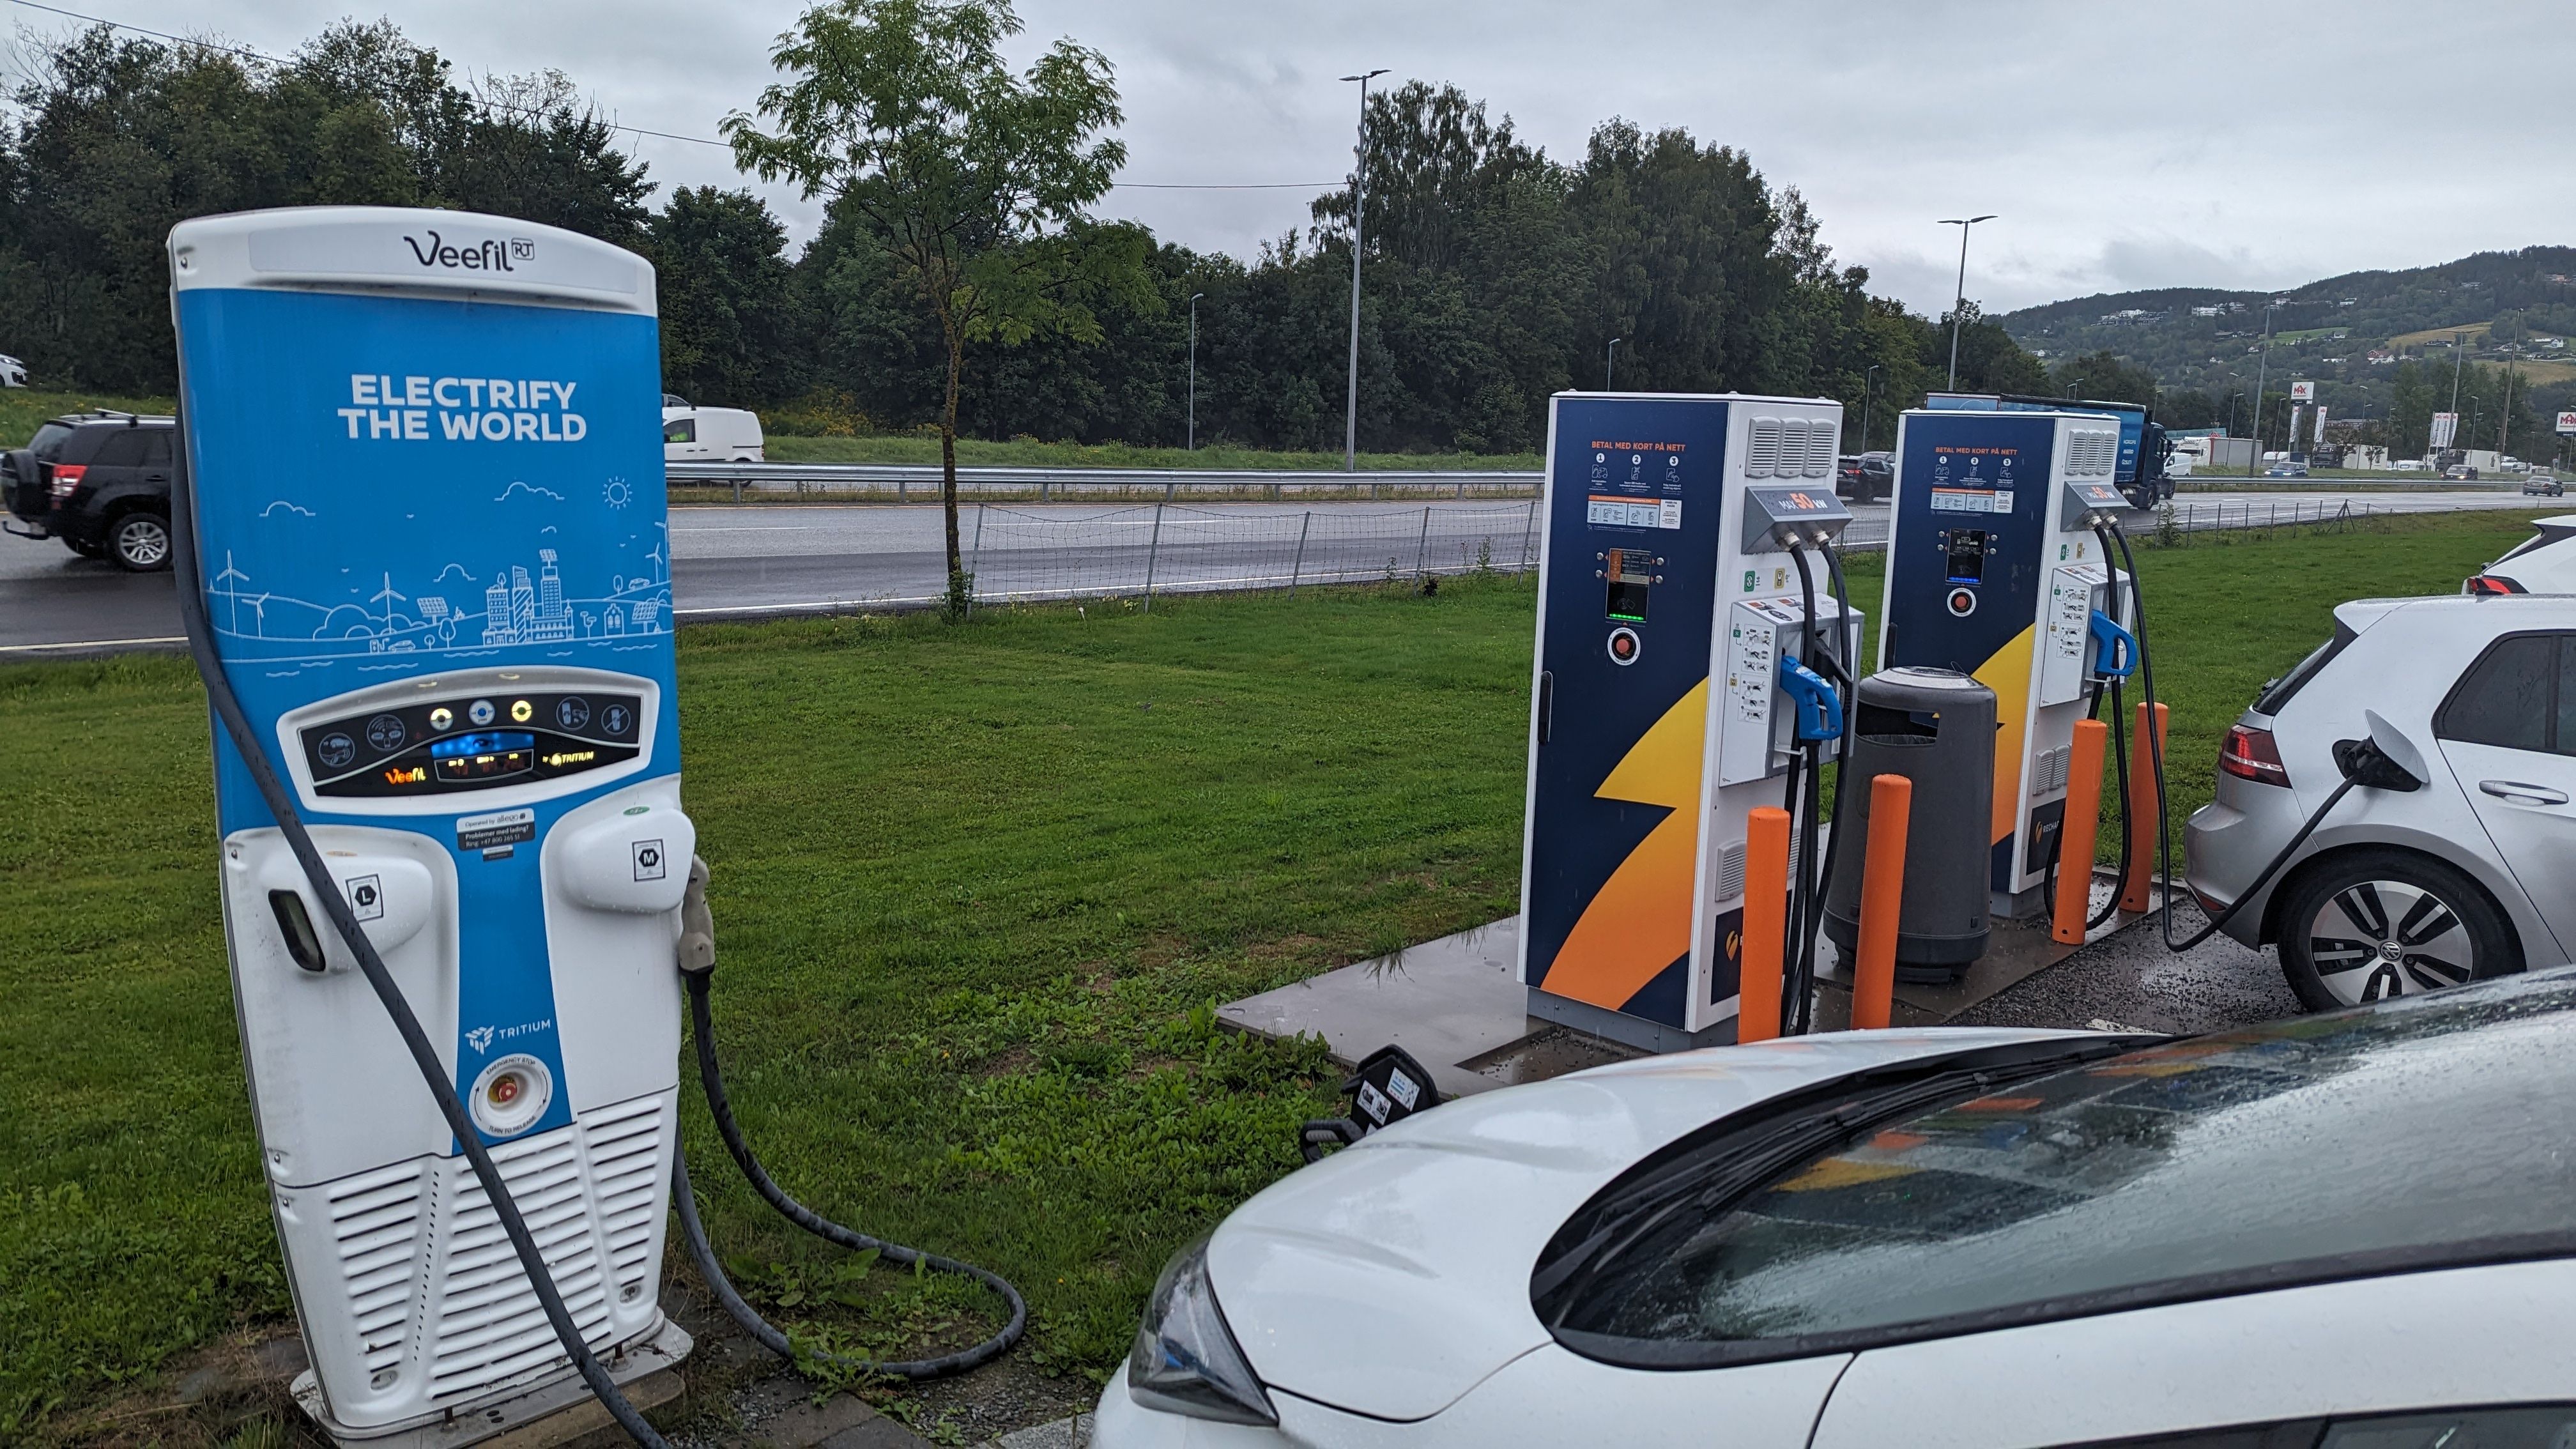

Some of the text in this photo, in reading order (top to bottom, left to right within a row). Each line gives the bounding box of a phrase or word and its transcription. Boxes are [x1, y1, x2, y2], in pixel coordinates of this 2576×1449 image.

[403, 230, 535, 272] Veefil RT
[351, 374, 577, 410] ELECTRIFY
[2294, 385, 2306, 394] MAX
[337, 408, 587, 441] THE WORLD
[1591, 441, 1613, 449] BETAL
[1633, 442, 1653, 450] KORT
[1655, 441, 1665, 451] PÅ
[1779, 500, 1799, 510] MAX
[1790, 493, 1814, 509] 50
[385, 767, 426, 785] Veefil
[562, 751, 594, 763] TRITIUM
[465, 819, 488, 828] Operated
[496, 814, 519, 823] allego
[465, 831, 495, 840] Problemer
[496, 827, 509, 836] med
[643, 852, 655, 865] M
[361, 889, 371, 903] L
[499, 1018, 551, 1039] TRITIUM
[486, 1057, 536, 1075] EMERGENCY STOP
[489, 1125, 503, 1134] TURN
[513, 1116, 537, 1133] RELEASE
